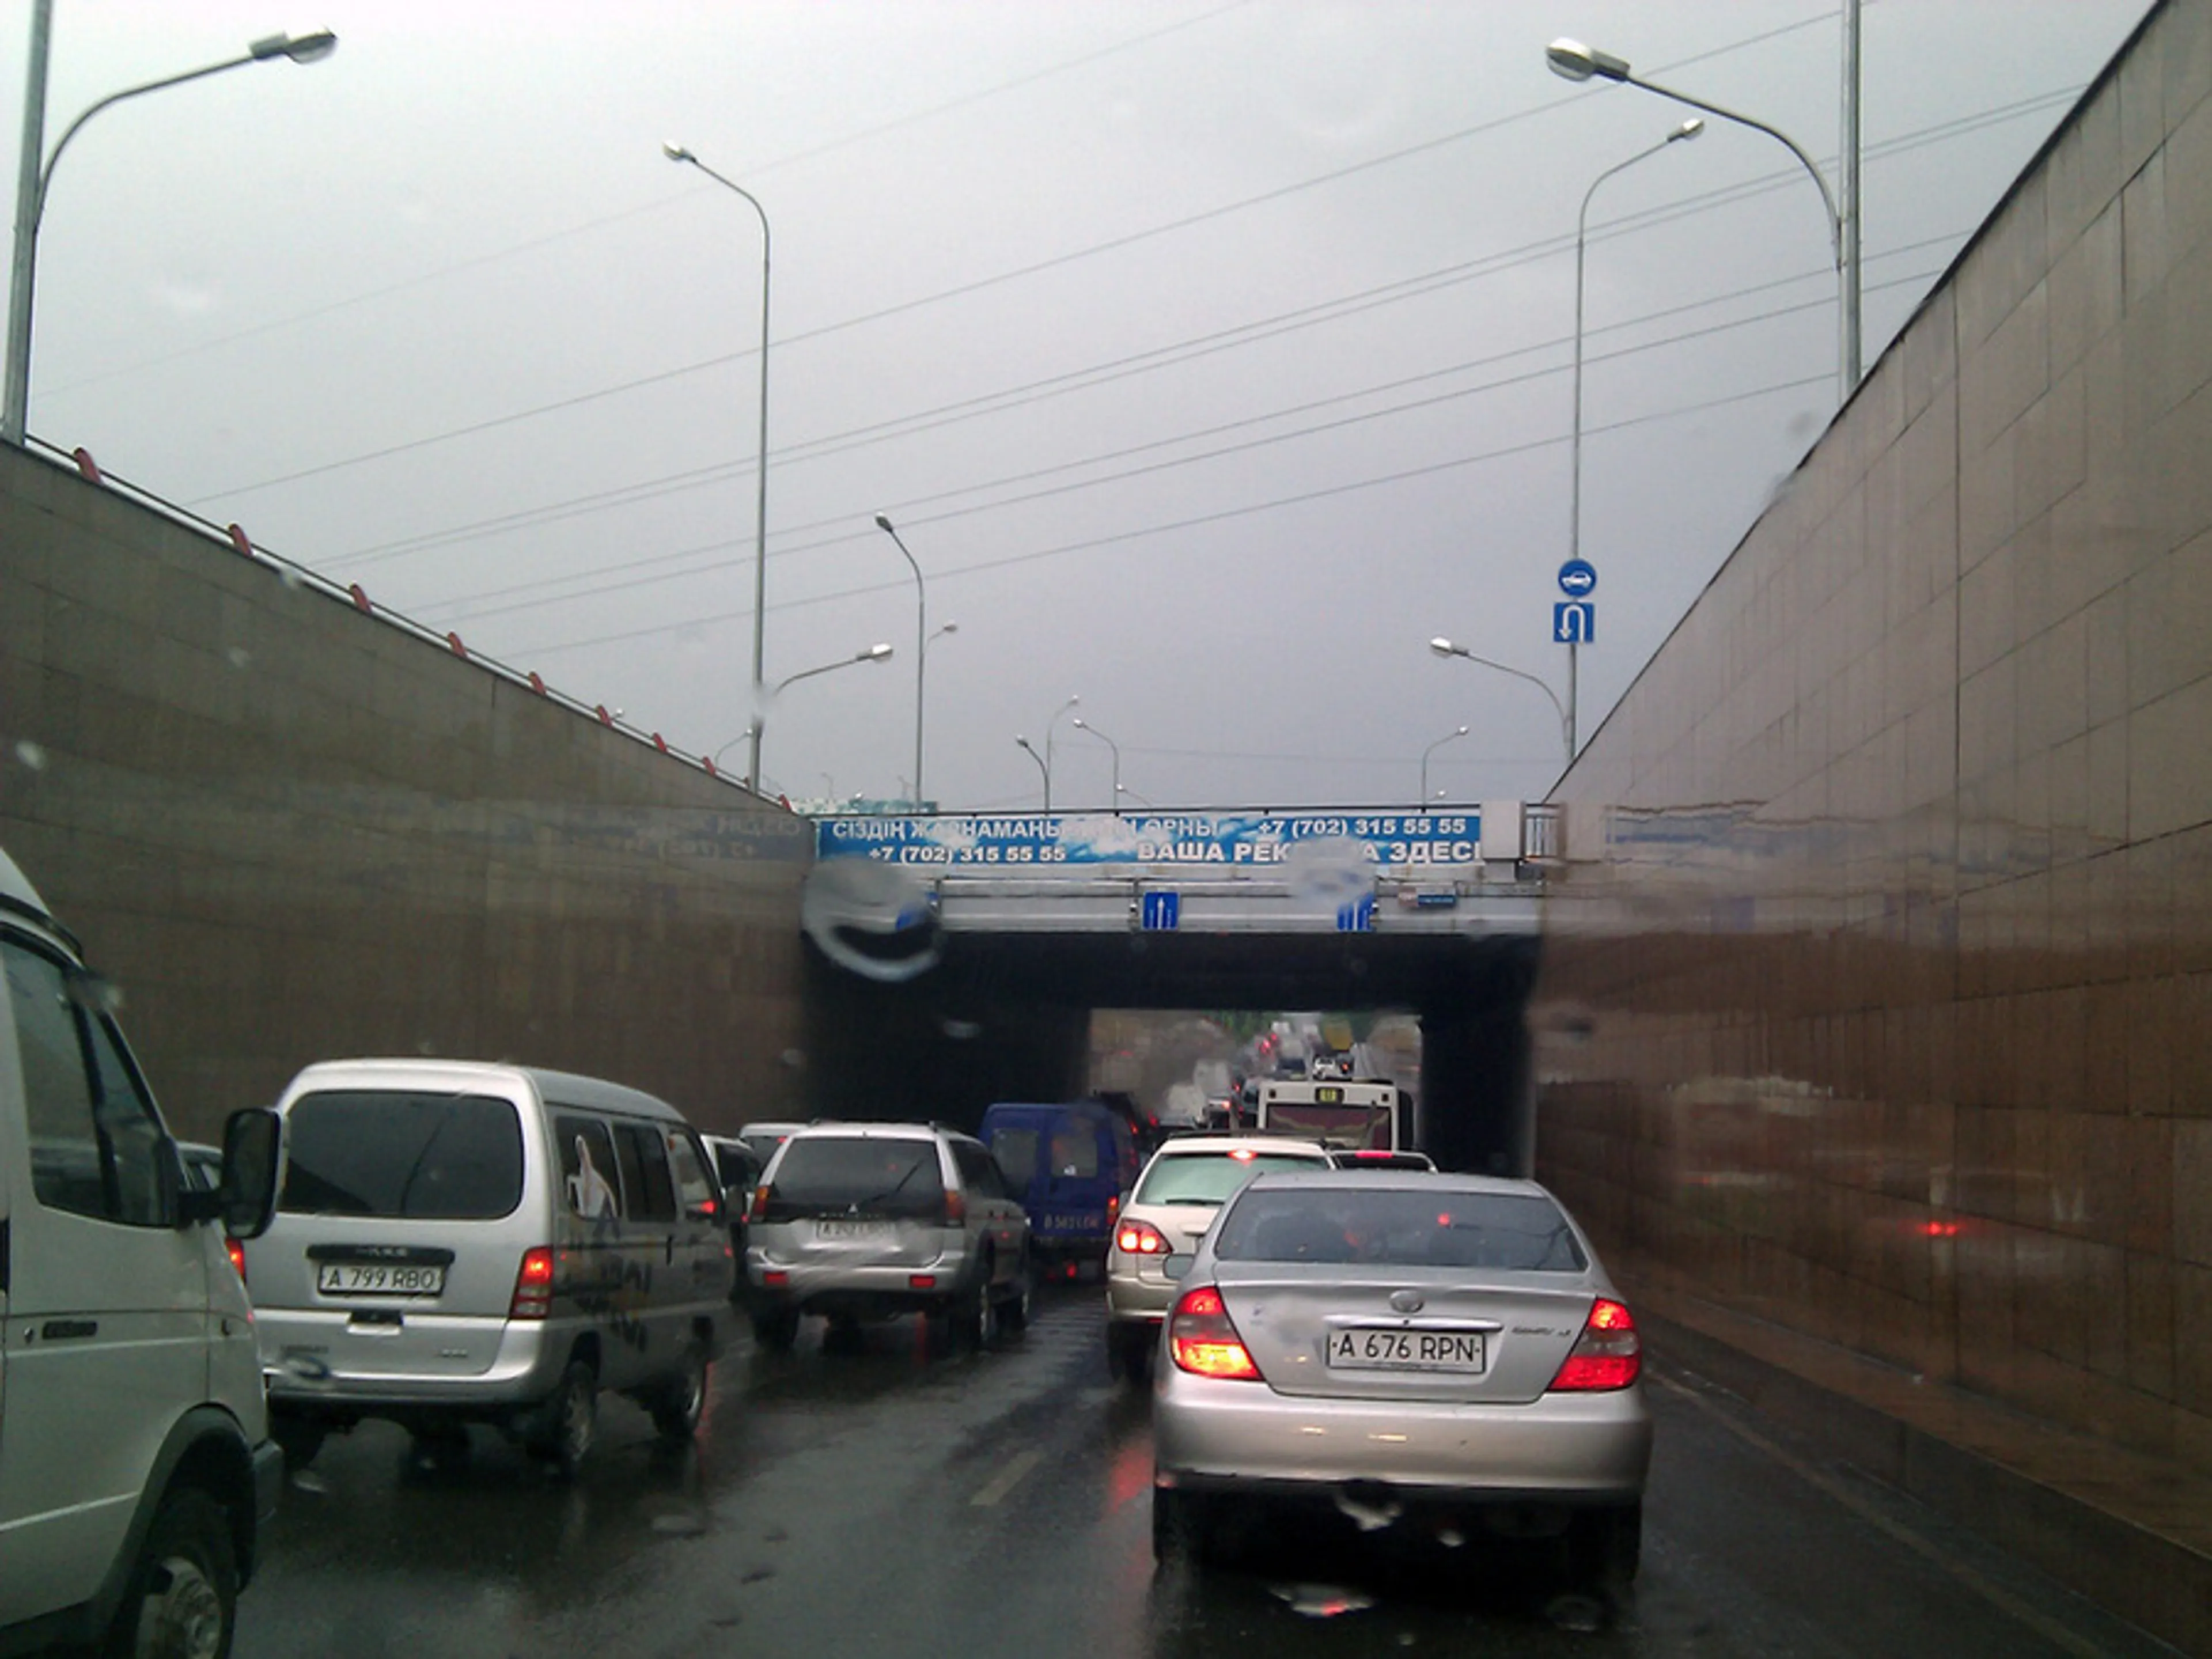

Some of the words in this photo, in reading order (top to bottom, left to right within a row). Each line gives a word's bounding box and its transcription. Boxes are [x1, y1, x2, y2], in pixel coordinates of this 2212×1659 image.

[1259, 820, 1285, 835] +7
[1292, 818, 1348, 839] (702)
[1355, 818, 1397, 835] 315
[1403, 818, 1431, 835] 55
[1438, 817, 1466, 834] 55
[869, 847, 894, 861] +7
[900, 846, 953, 864] (702)
[960, 846, 999, 862] 315
[1006, 846, 1033, 862] 55
[1039, 846, 1065, 862] 55
[1138, 841, 1225, 861] ВАША
[327, 1269, 341, 1287] A
[350, 1268, 387, 1287] 799
[1338, 1334, 1355, 1357] A
[1365, 1334, 1412, 1359] 676
[1421, 1336, 1474, 1362] RPN
